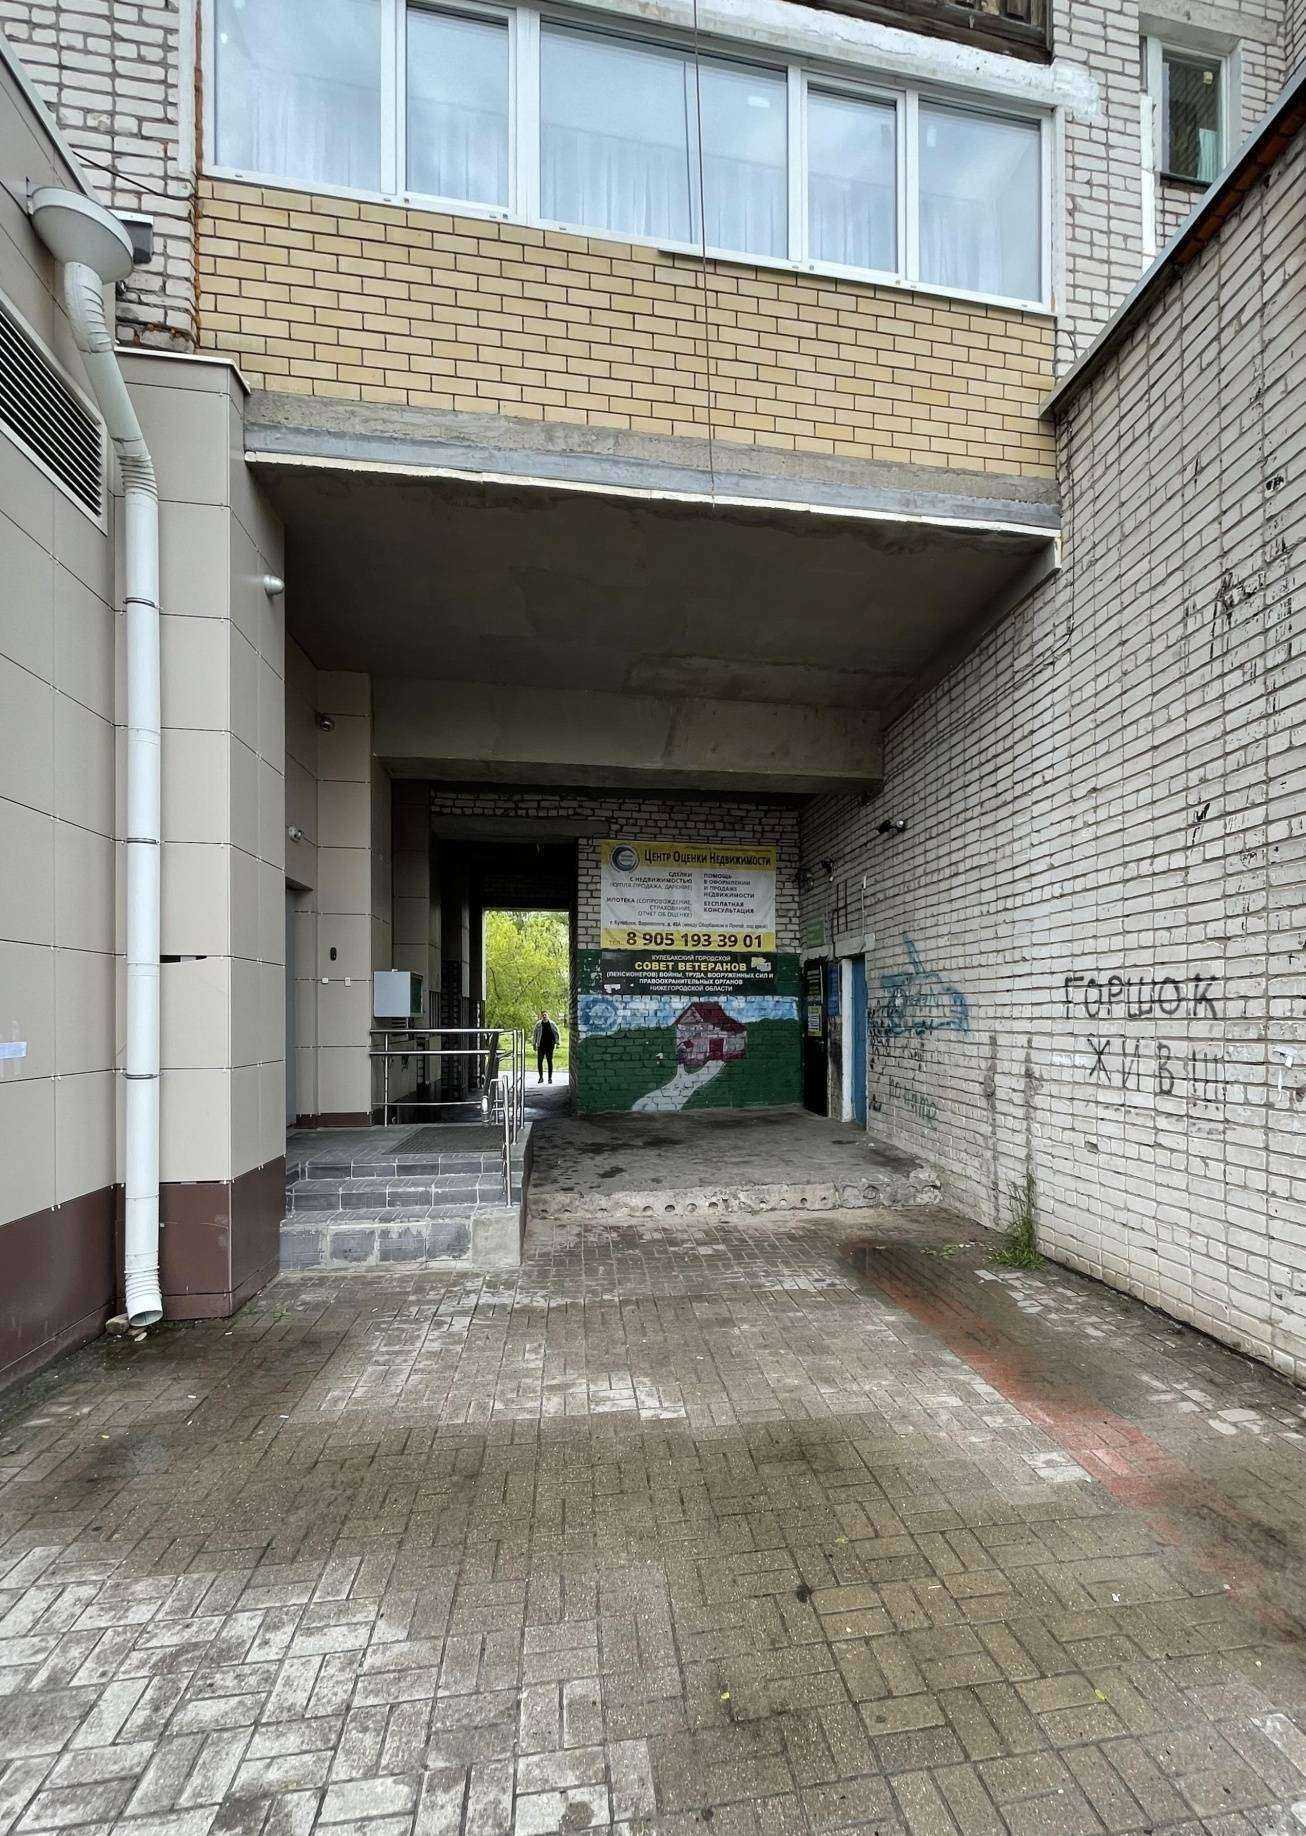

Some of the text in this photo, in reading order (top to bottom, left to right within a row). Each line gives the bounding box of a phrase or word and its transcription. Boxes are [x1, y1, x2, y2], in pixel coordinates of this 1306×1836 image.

[627, 932, 637, 945] 8
[643, 933, 675, 946] 905
[681, 933, 712, 947] 193
[718, 934, 738, 947] 39
[743, 934, 762, 948] 01
[635, 962, 746, 972] СОВЕТ ВЕТЕРАНОВ
[1065, 972, 1218, 1019] ГОРШОК
